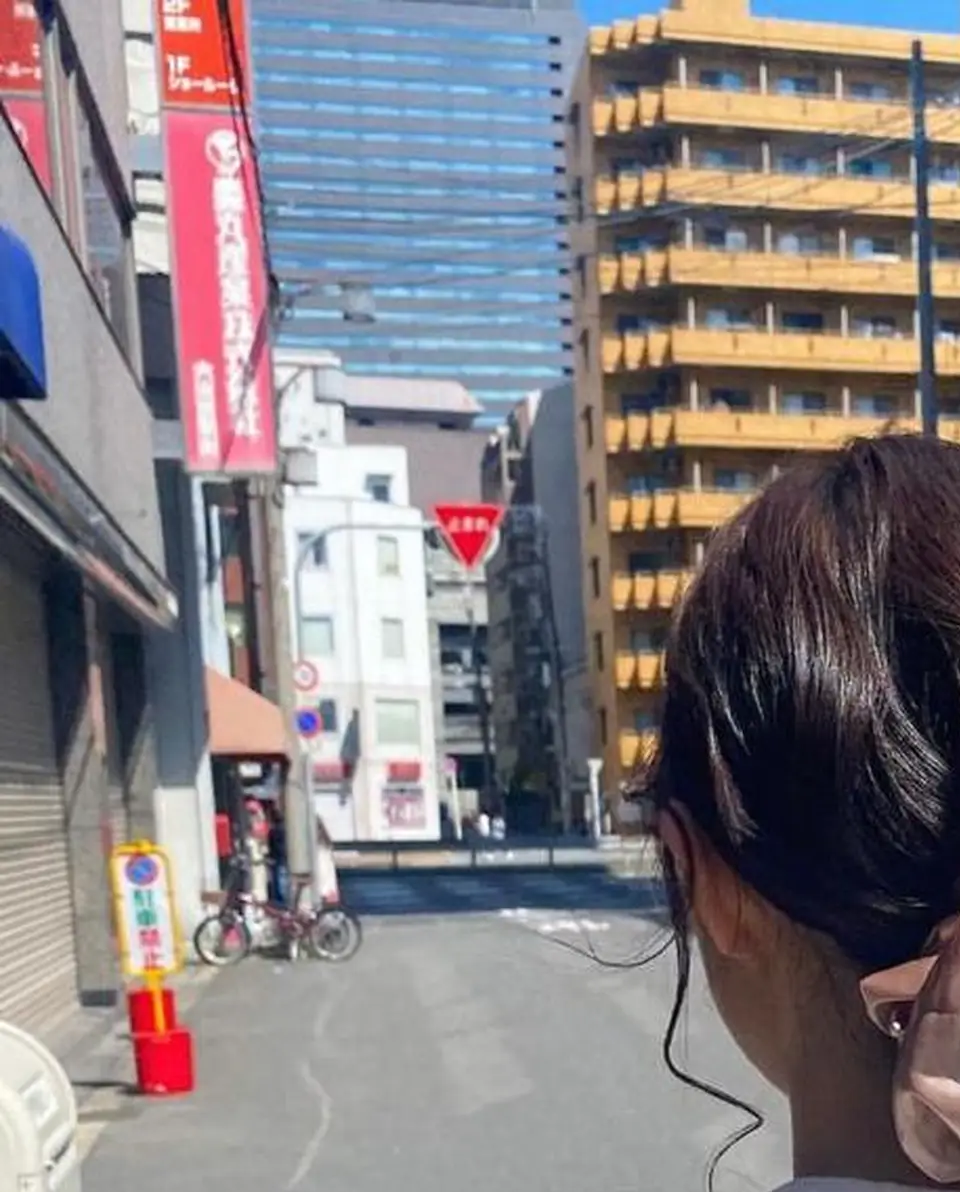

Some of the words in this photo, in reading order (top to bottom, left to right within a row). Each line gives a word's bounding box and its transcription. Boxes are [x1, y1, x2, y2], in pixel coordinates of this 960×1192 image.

[166, 54, 191, 77] 1F
[131, 888, 164, 970] 駐車禁止
